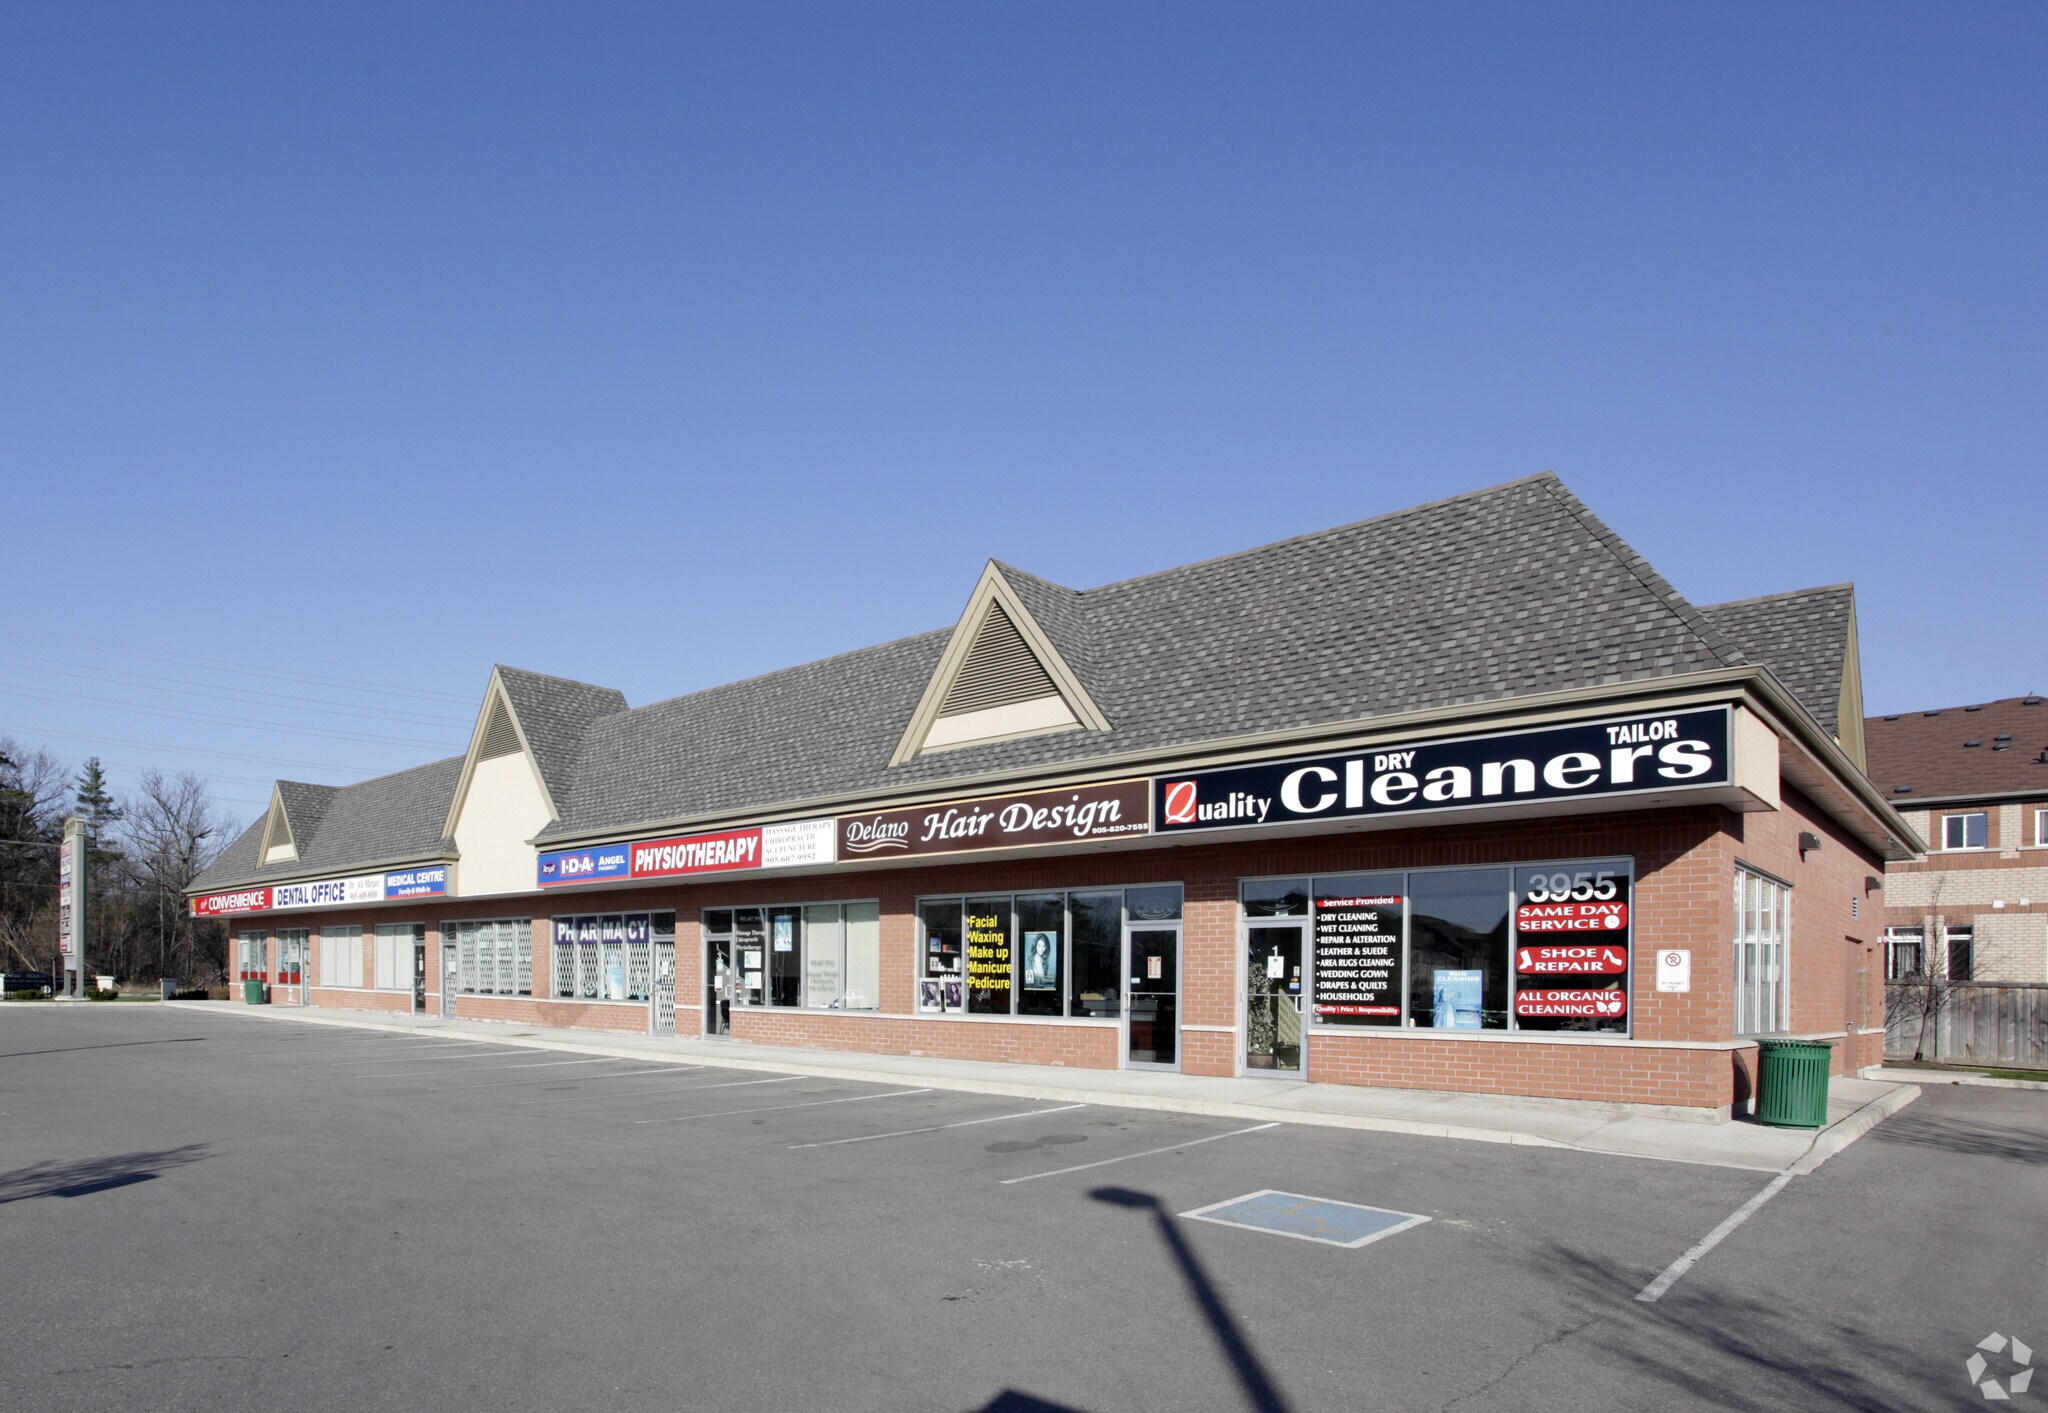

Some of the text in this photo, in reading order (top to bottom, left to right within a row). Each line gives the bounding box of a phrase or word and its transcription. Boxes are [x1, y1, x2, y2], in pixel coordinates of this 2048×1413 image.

[1607, 720, 1678, 745] TAILOR
[1375, 751, 1416, 772] DRY
[1165, 740, 1713, 825] Quality Cleaners
[920, 795, 1121, 841] Hair Design
[765, 821, 831, 835] MASSAGE THERAPY
[846, 816, 908, 842] Delano
[1092, 823, 1148, 834] 905-820-7555
[765, 833, 816, 845] CHIROPRACTIC
[634, 836, 759, 872] PHYSIOTHERAPY
[766, 843, 816, 854] ACUPUNCTURE
[598, 855, 625, 866] ANGEL
[387, 870, 444, 887] MEDICAL CENTRE
[1527, 871, 1617, 903] 3955
[277, 882, 345, 906] DENTAL OFFICE
[208, 891, 264, 910] CONVENIENCE
[1323, 896, 1394, 907] Service Provided
[1321, 912, 1378, 922] DRY CLEANING
[1519, 905, 1622, 917] SAME DAY
[969, 915, 997, 928] Facial
[1519, 919, 1600, 930] SERVICE
[1320, 924, 1378, 933] WET CLEANING
[969, 931, 1004, 946] Waxing
[1320, 936, 1344, 944] REPAIR
[1352, 935, 1396, 943] ALTERATION
[969, 946, 1009, 960] Make up
[1272, 945, 1278, 957] 1
[1320, 947, 1388, 956] LEATHER & SUEDE
[1540, 948, 1597, 958] SHOE
[969, 961, 1011, 974] Manicure
[1320, 958, 1395, 967] AREA RUGS CLEANING
[1535, 961, 1604, 971] REPAIR
[1320, 970, 1389, 978] WEDDING GOWN
[969, 976, 1010, 989] Pedicure
[1320, 981, 1387, 991] DRAPES & QUILTS
[1320, 992, 1375, 1001] HOUSEHOLDS
[1518, 991, 1621, 1001] ALL ORGANIC
[1316, 1005, 1336, 1014] Quality
[1340, 1005, 1354, 1013] Price
[1358, 1006, 1399, 1015] Responsibility
[1518, 1004, 1595, 1014] CLEANING
